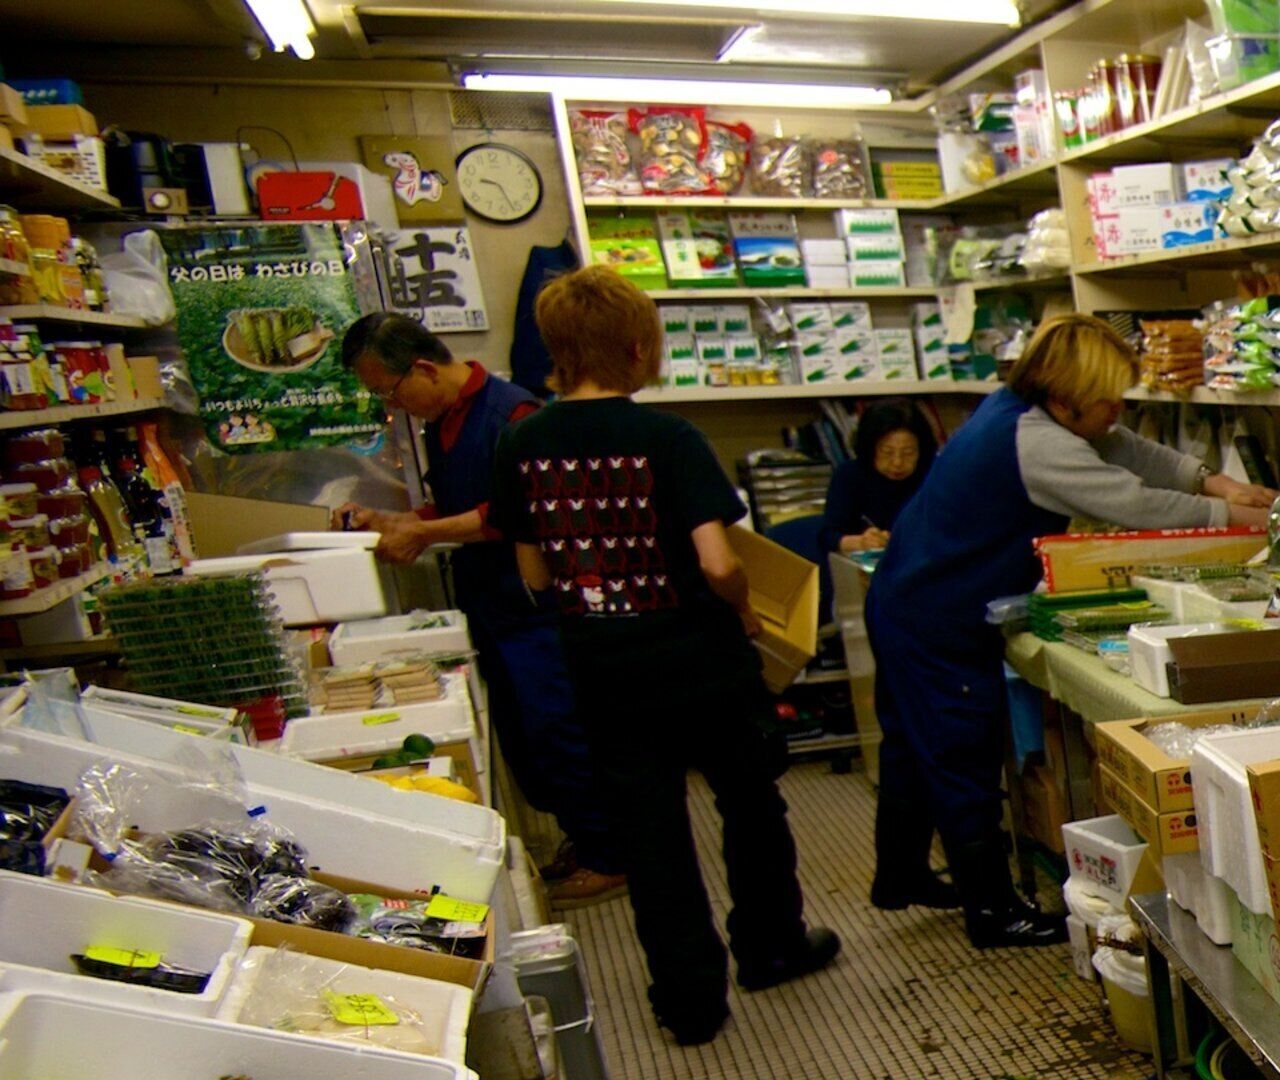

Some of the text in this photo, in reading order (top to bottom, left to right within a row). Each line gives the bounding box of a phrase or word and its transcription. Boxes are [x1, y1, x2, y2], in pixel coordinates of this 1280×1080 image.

[256, 259, 346, 279] わさびの日
